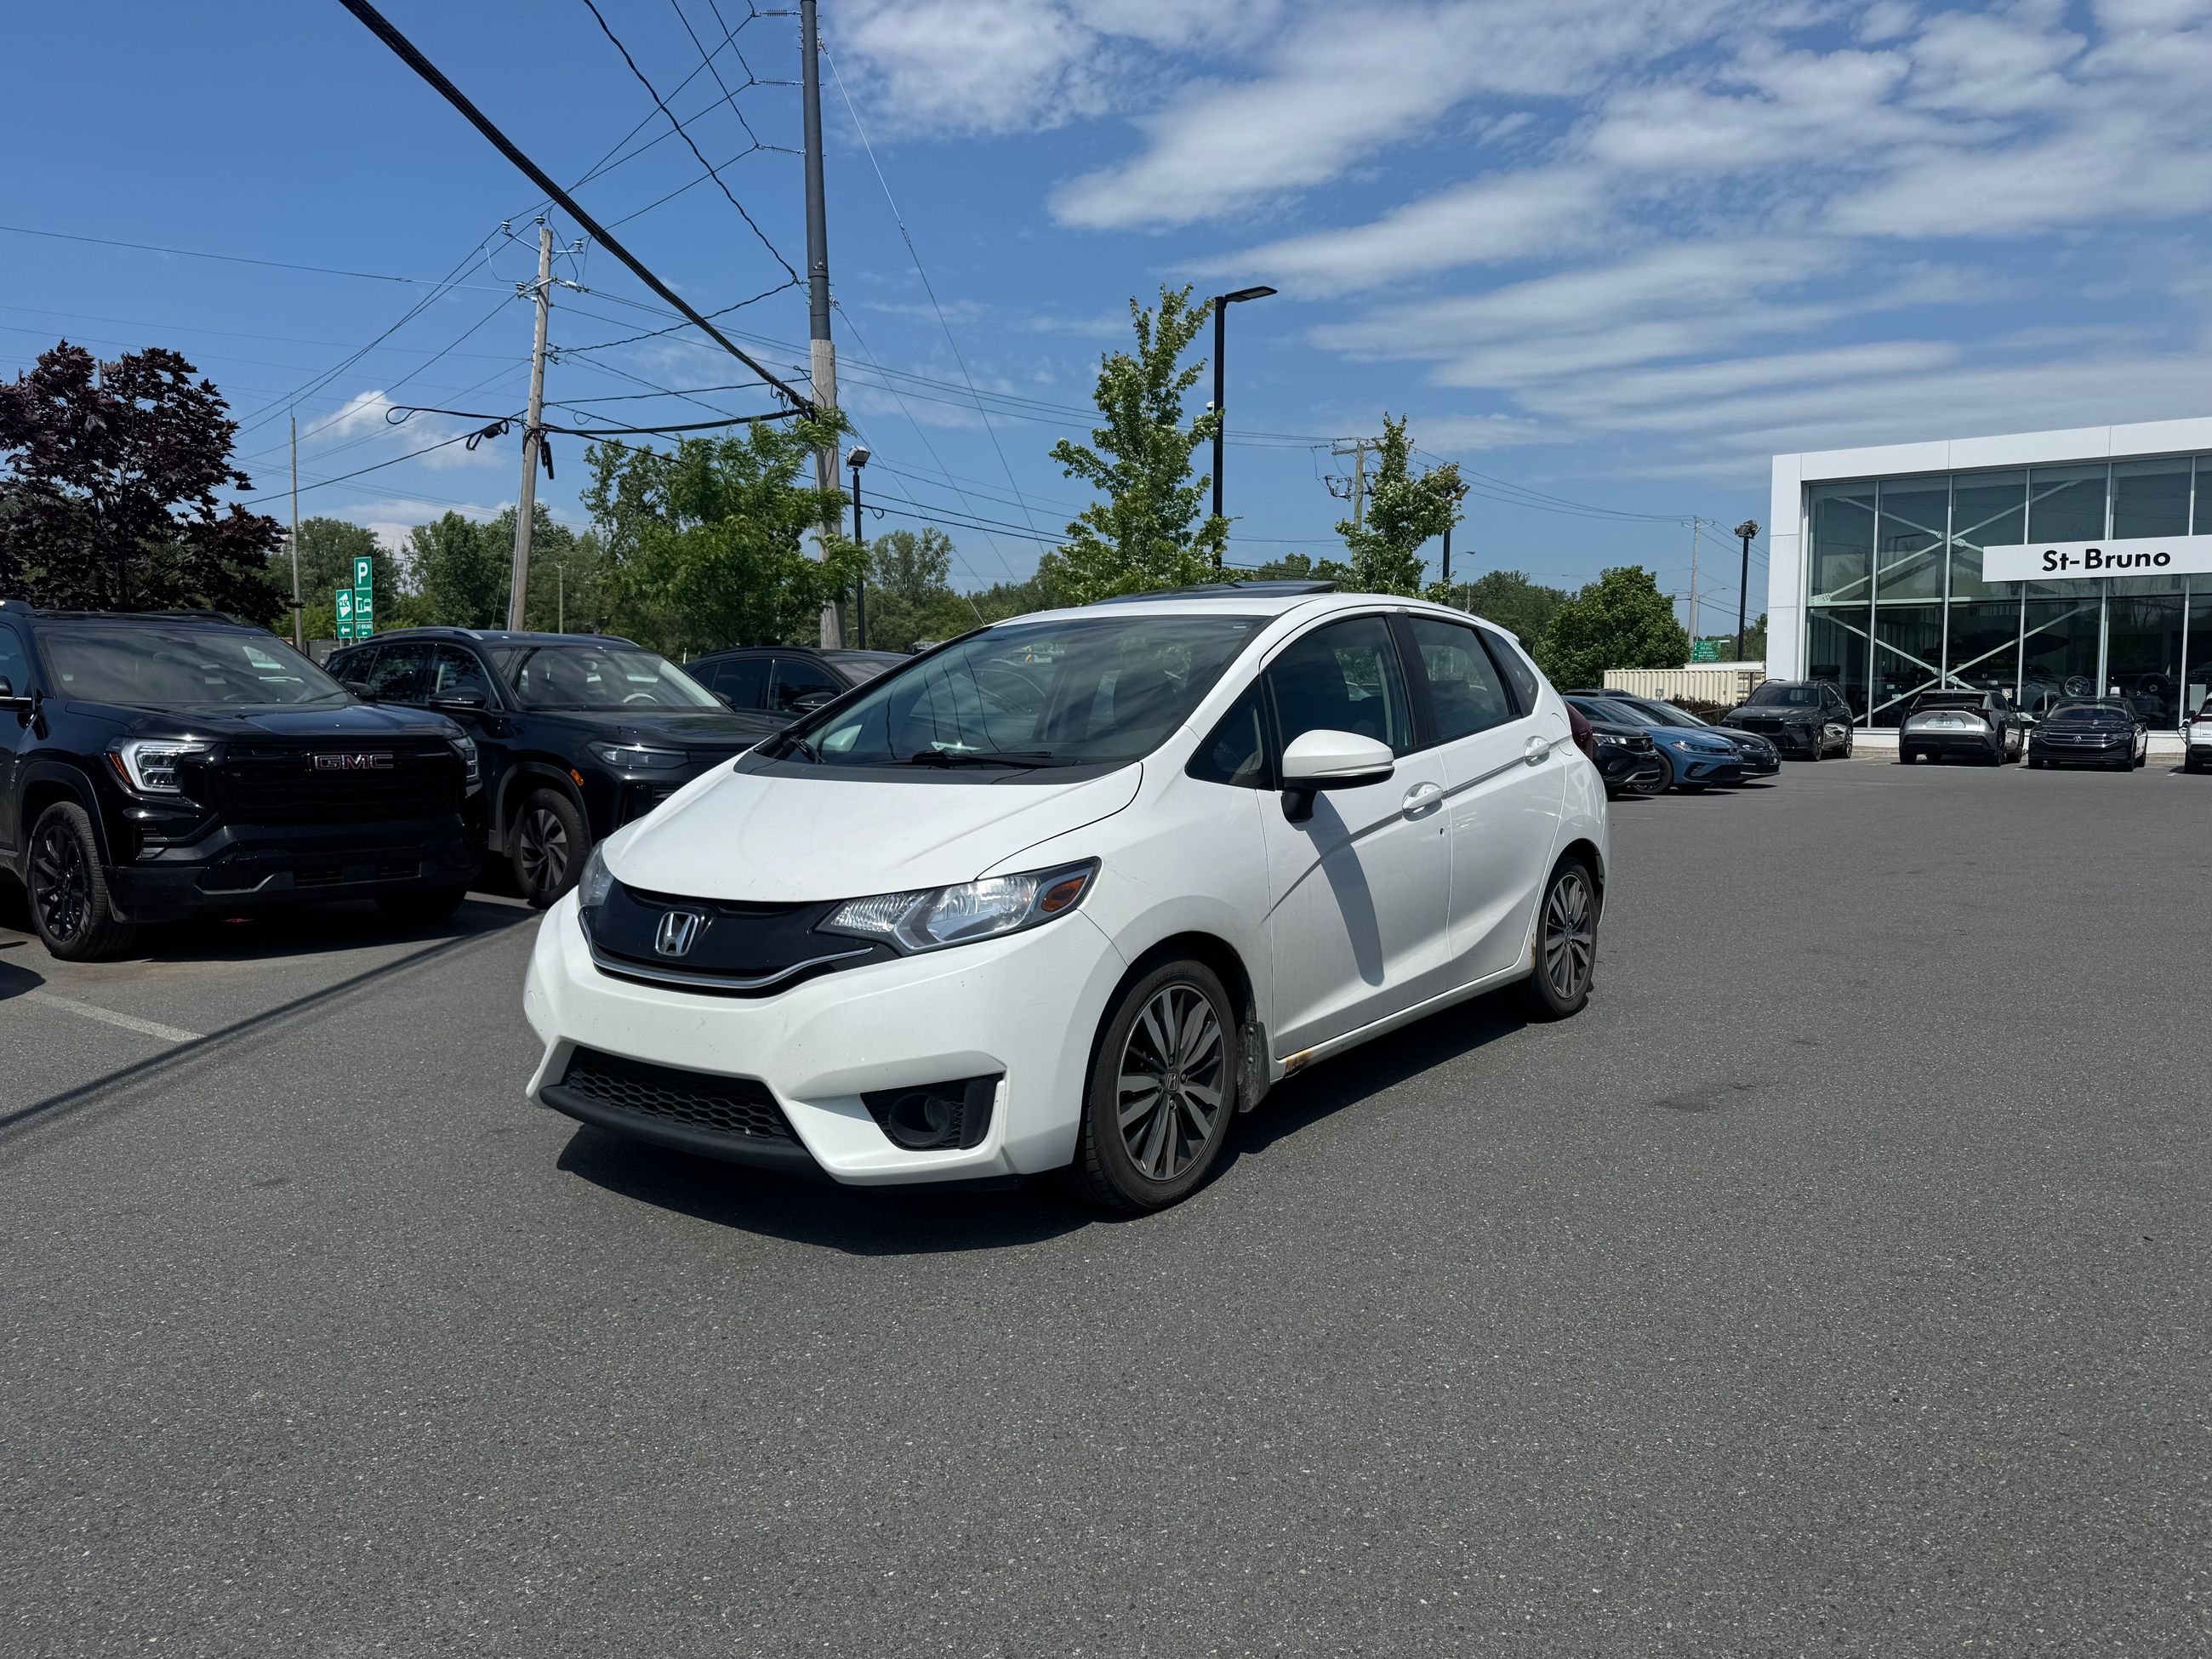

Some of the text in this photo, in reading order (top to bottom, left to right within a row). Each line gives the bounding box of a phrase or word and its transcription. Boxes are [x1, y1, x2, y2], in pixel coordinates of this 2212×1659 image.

[2042, 548, 2171, 572] St-Bruno
[358, 562, 368, 584] P
[314, 754, 394, 770] GMC
